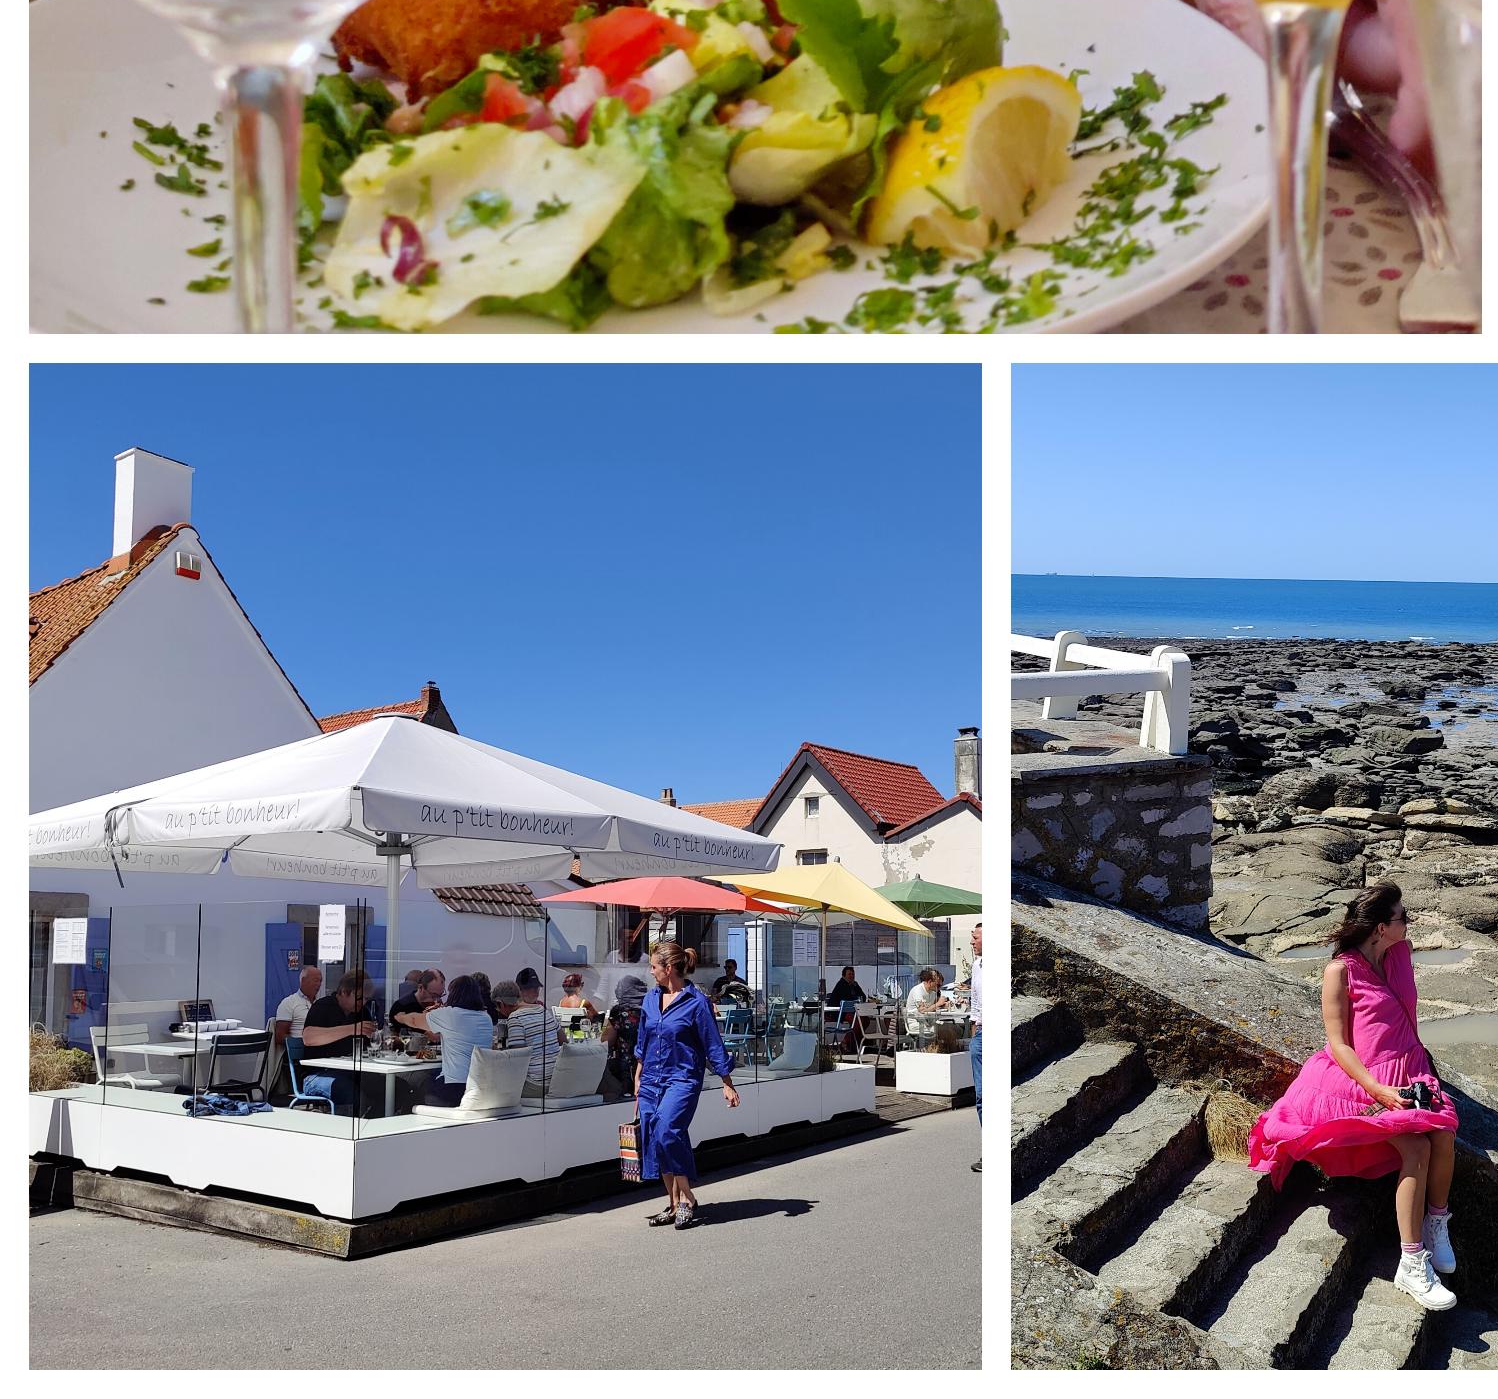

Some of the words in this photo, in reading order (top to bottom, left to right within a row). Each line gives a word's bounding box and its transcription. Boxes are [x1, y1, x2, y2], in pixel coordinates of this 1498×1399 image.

[165, 812, 183, 830] au
[226, 799, 300, 824] bonheur!
[421, 804, 447, 824] au
[500, 807, 574, 836] bonheur!
[35, 820, 91, 844] bonheur!
[653, 832, 670, 849] au
[704, 836, 755, 861] bonheur!
